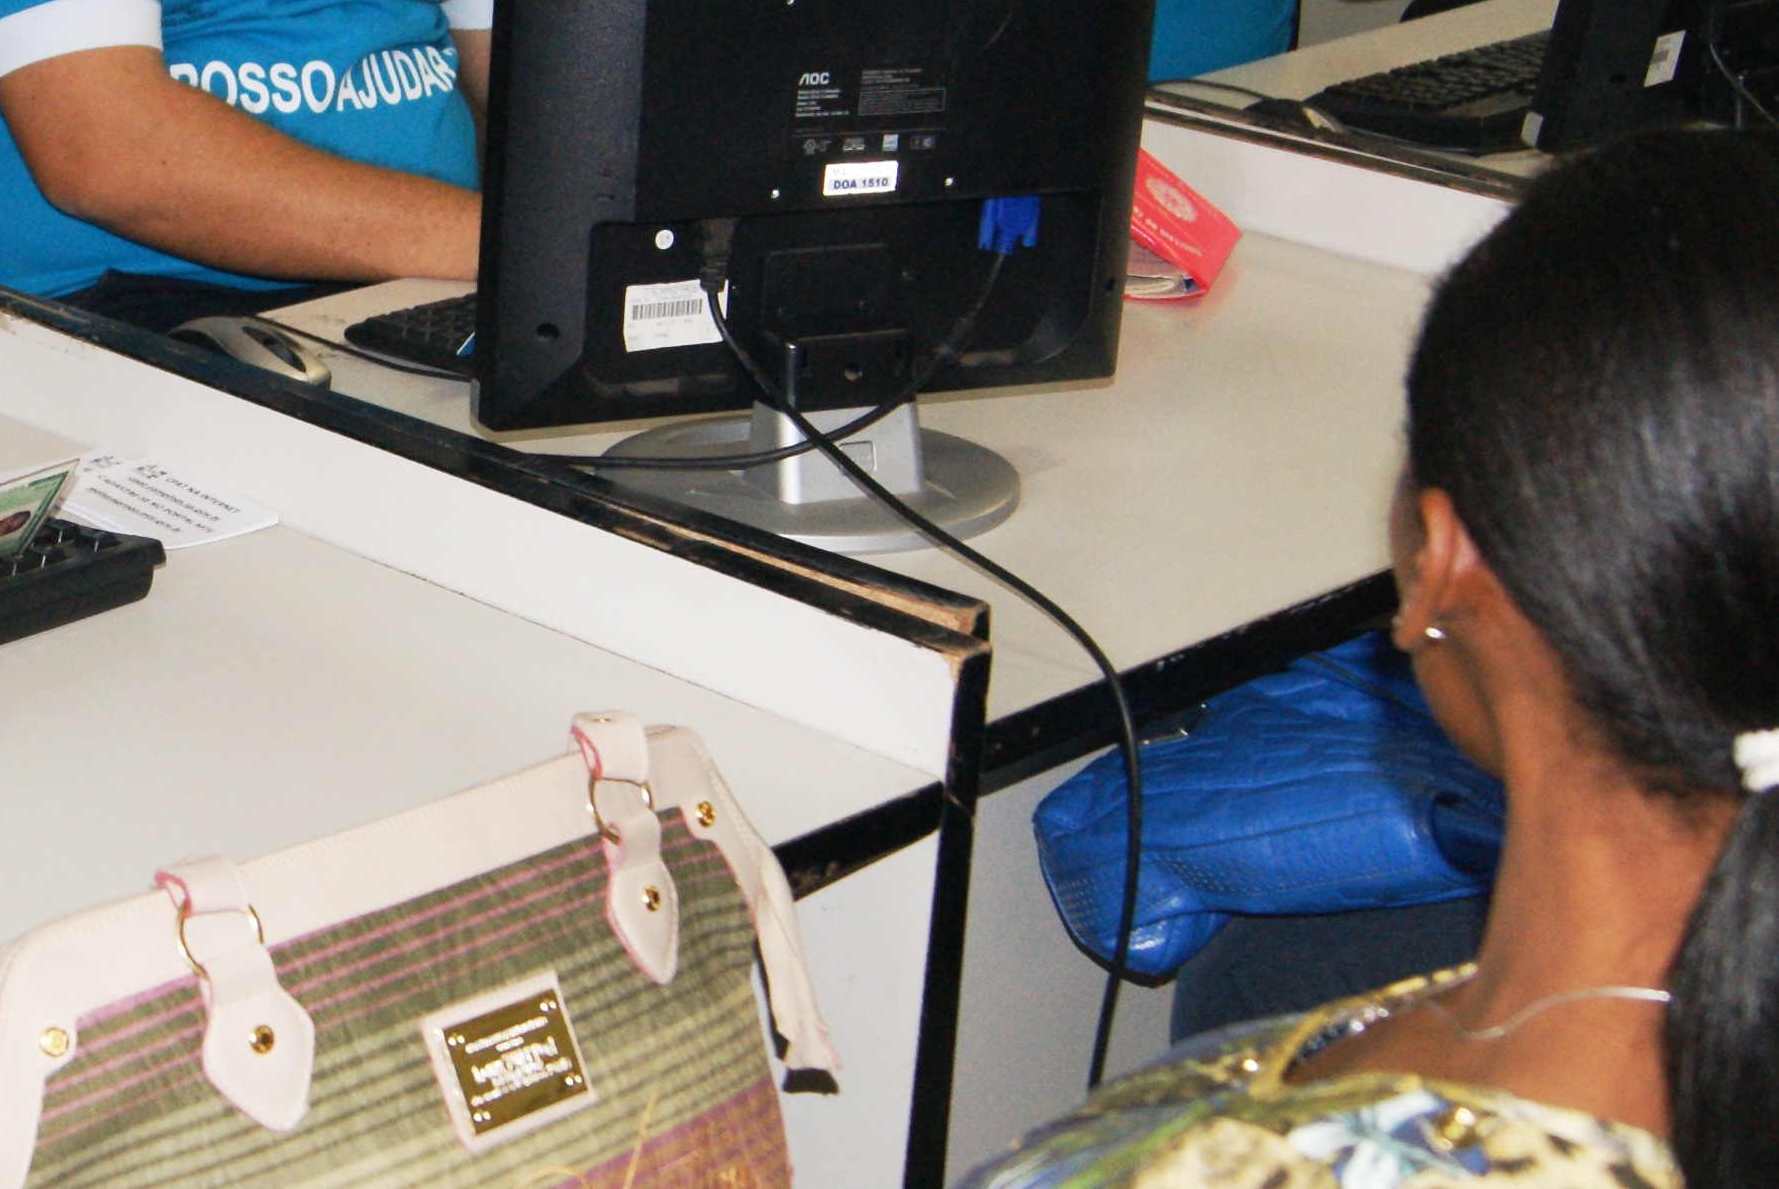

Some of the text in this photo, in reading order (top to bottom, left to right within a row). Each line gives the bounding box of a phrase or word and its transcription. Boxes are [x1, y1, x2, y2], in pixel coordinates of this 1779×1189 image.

[798, 72, 830, 86] AOC
[833, 177, 889, 190] DOA 1510
[200, 492, 241, 514] INTERNET
